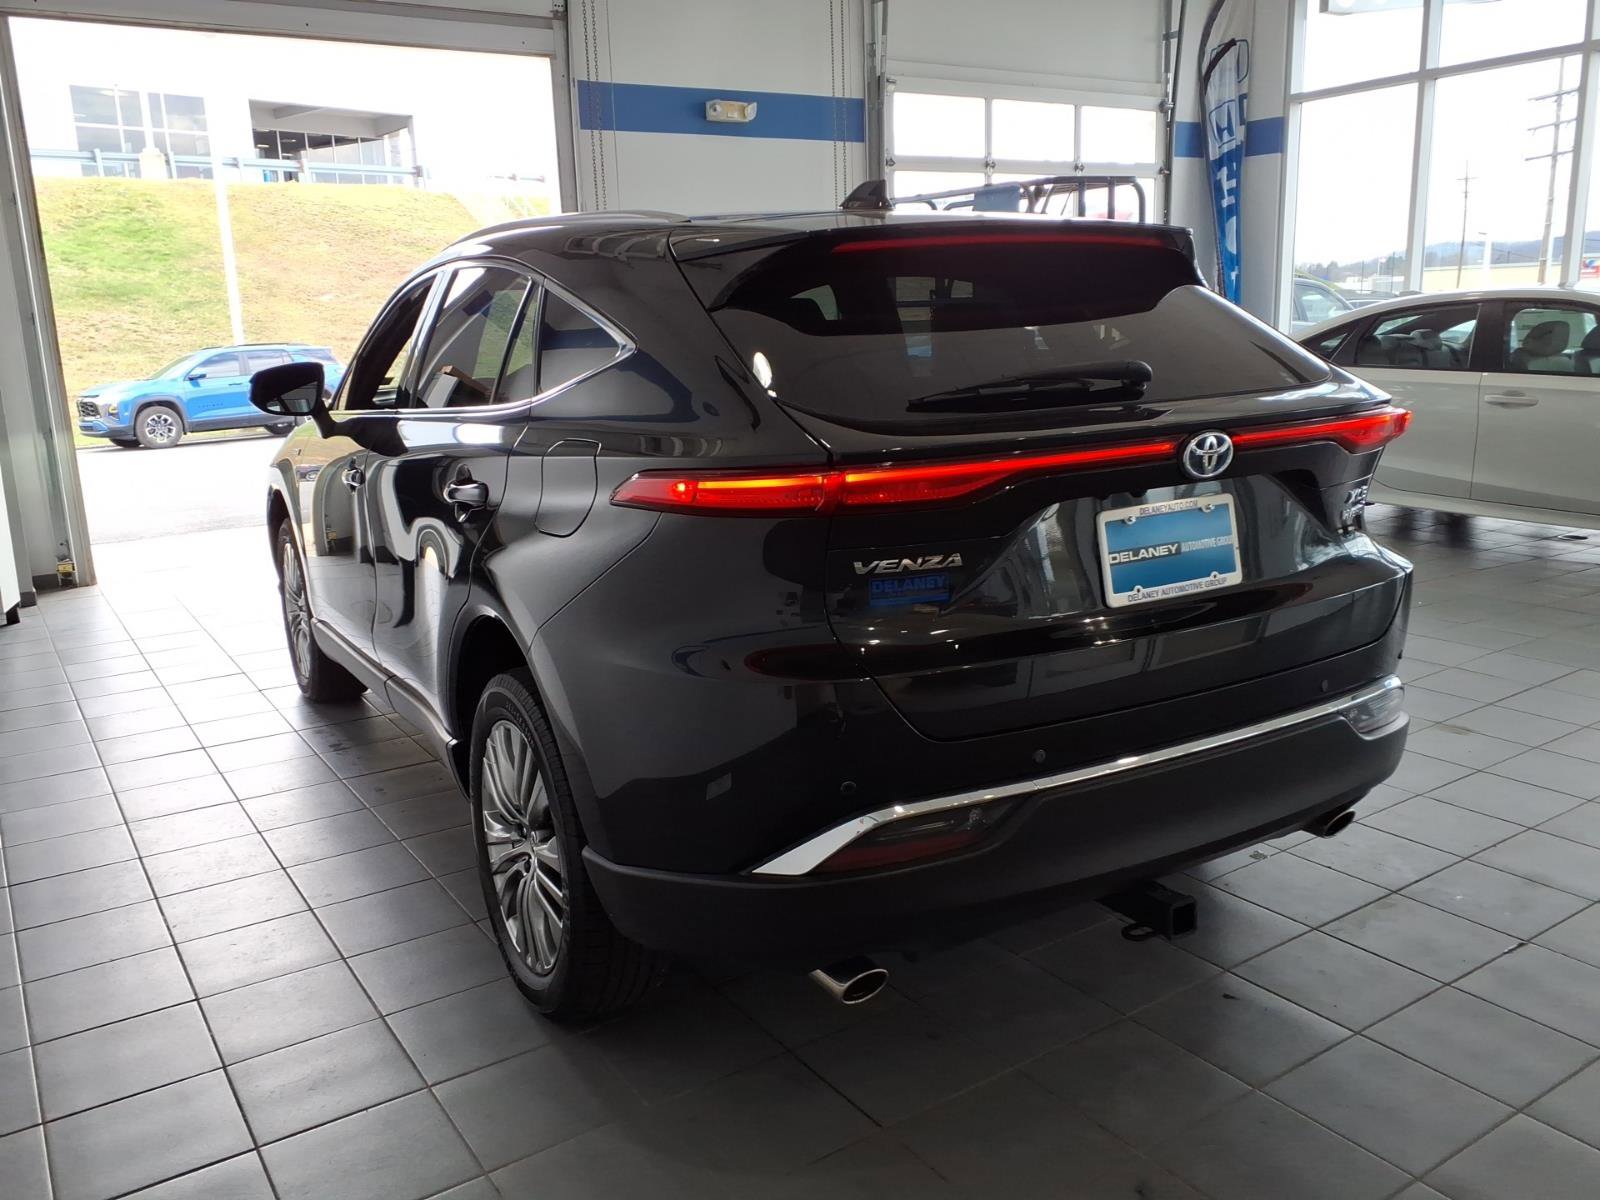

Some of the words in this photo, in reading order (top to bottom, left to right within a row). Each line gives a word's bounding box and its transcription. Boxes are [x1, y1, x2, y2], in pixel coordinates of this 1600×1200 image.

[853, 552, 963, 575] VENZA
[1110, 543, 1178, 564] DELANEY
[871, 574, 946, 593] DELANEY
[1127, 589, 1160, 603] DELANEY
[1160, 580, 1205, 597] AUTOMOTIVE
[1204, 577, 1228, 588] GROUP
